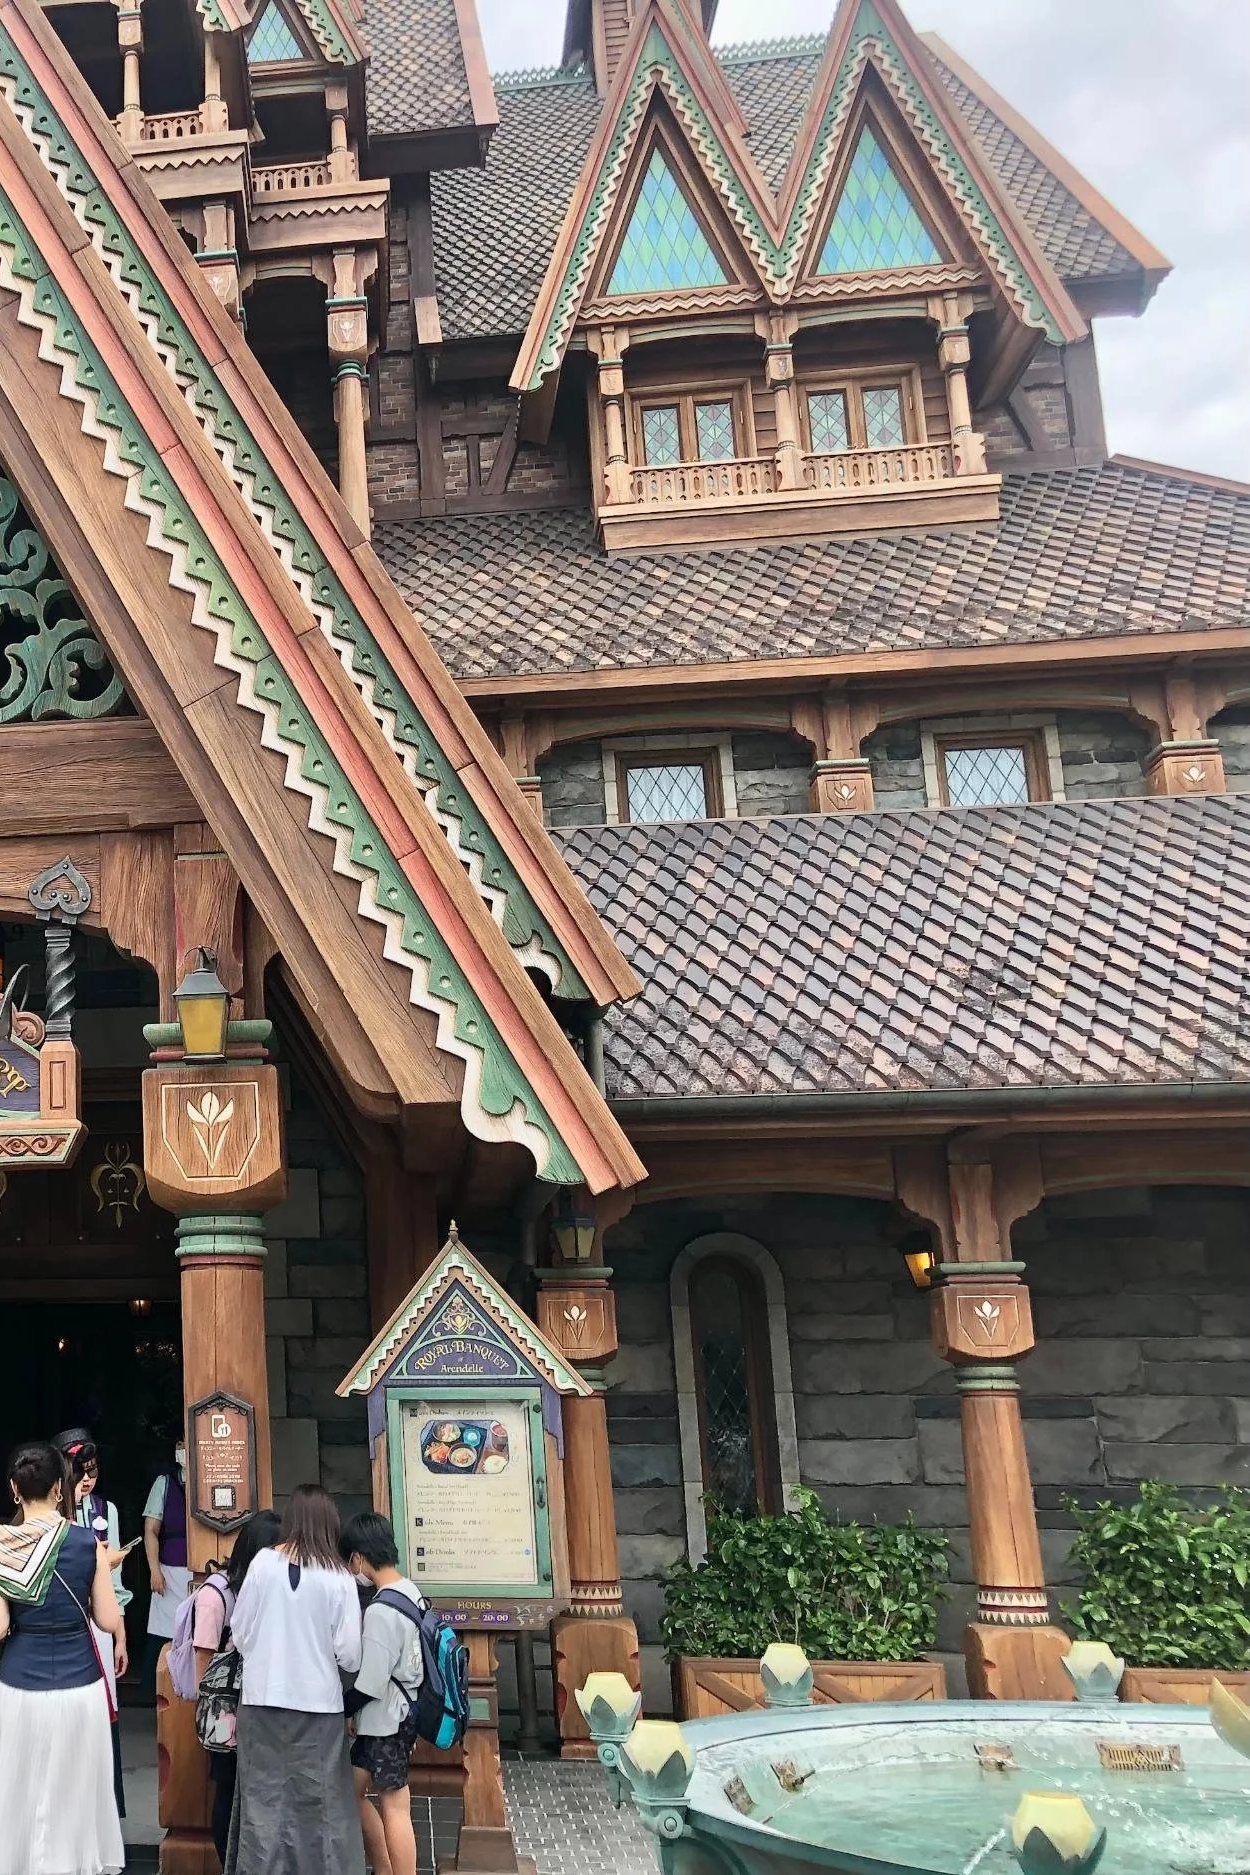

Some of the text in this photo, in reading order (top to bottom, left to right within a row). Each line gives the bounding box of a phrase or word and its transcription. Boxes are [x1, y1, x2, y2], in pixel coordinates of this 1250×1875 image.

[414, 1340, 510, 1370] ROYAL BANQUET
[440, 1363, 484, 1373] Arendelle
[457, 1601, 492, 1610] HOURS
